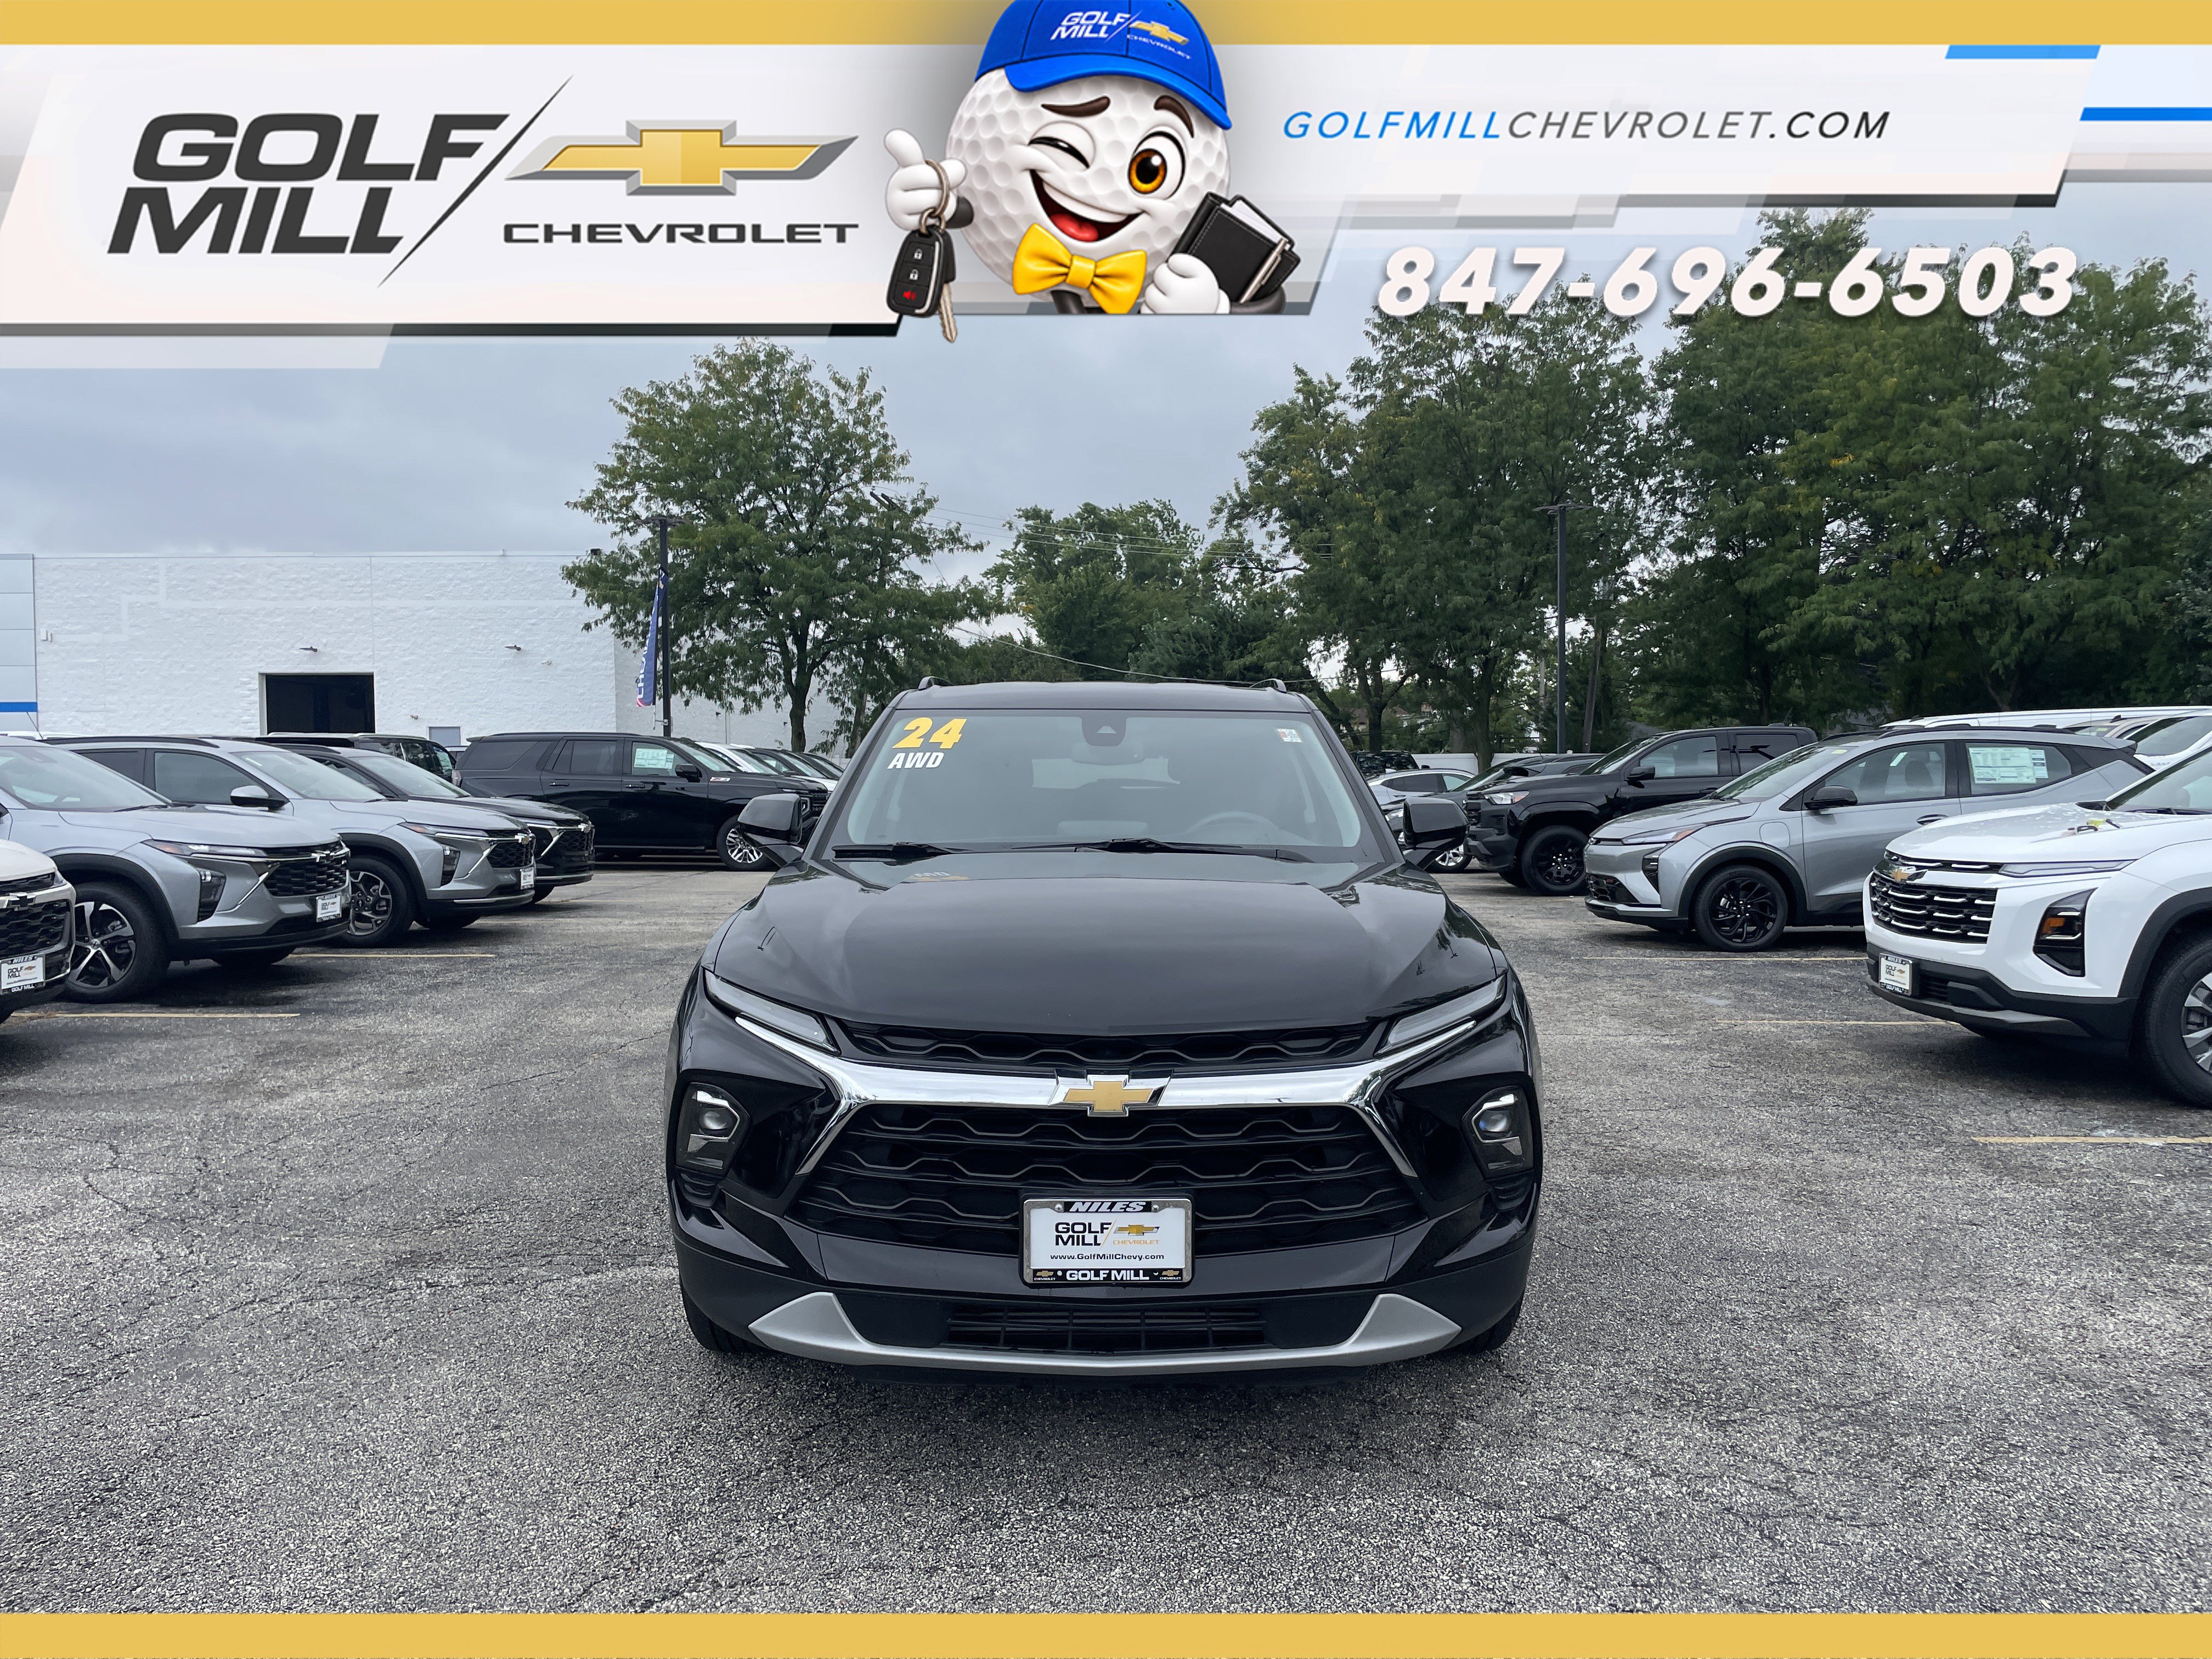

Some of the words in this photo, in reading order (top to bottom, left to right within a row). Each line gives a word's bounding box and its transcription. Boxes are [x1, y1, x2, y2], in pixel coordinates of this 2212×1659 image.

[891, 716, 967, 749] 24
[887, 752, 945, 769] AWD
[1069, 1201, 1146, 1212] NILES
[1055, 1222, 1113, 1234] GOLF
[1055, 1234, 1102, 1246] MILL
[1066, 1270, 1109, 1280] GOLF
[1111, 1270, 1149, 1280] MILL
